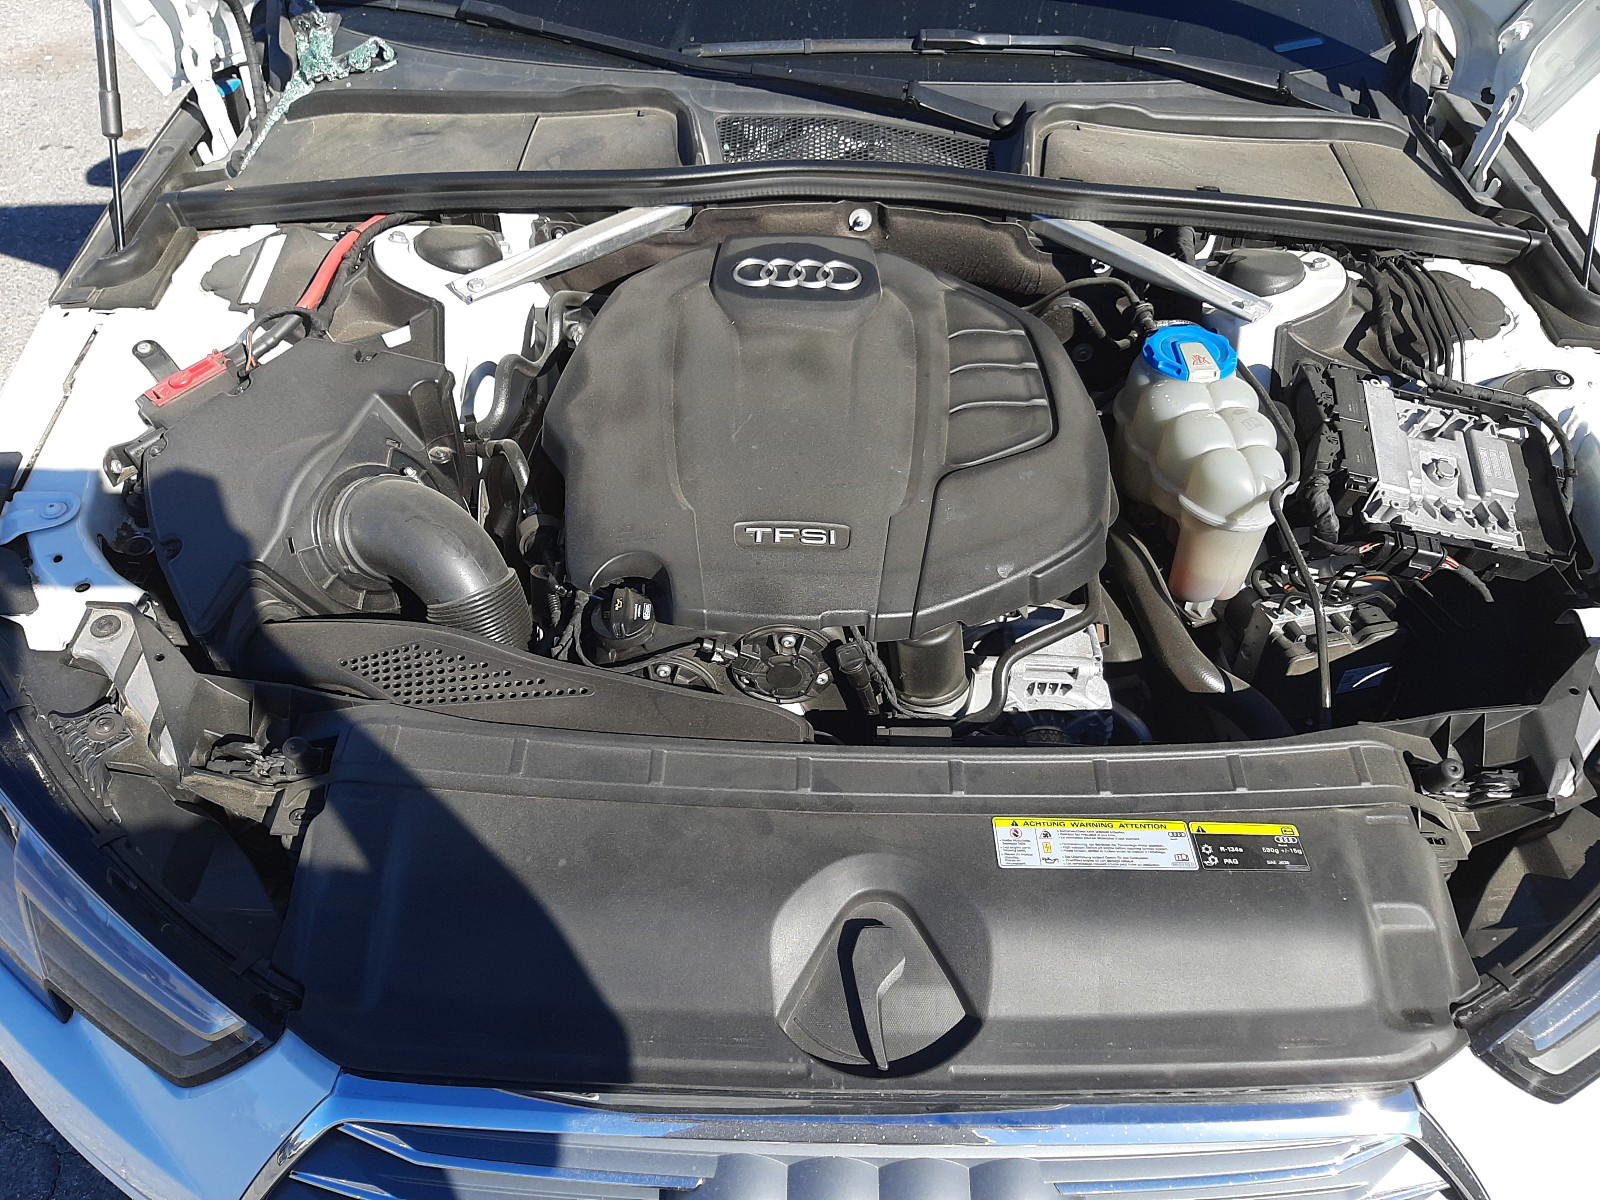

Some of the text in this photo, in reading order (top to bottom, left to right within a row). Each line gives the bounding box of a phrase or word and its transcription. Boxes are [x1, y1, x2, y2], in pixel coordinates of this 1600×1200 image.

[745, 527, 836, 545] TFSI
[1023, 820, 1066, 828] ACHTUNG
[1070, 821, 1114, 829] WARNING
